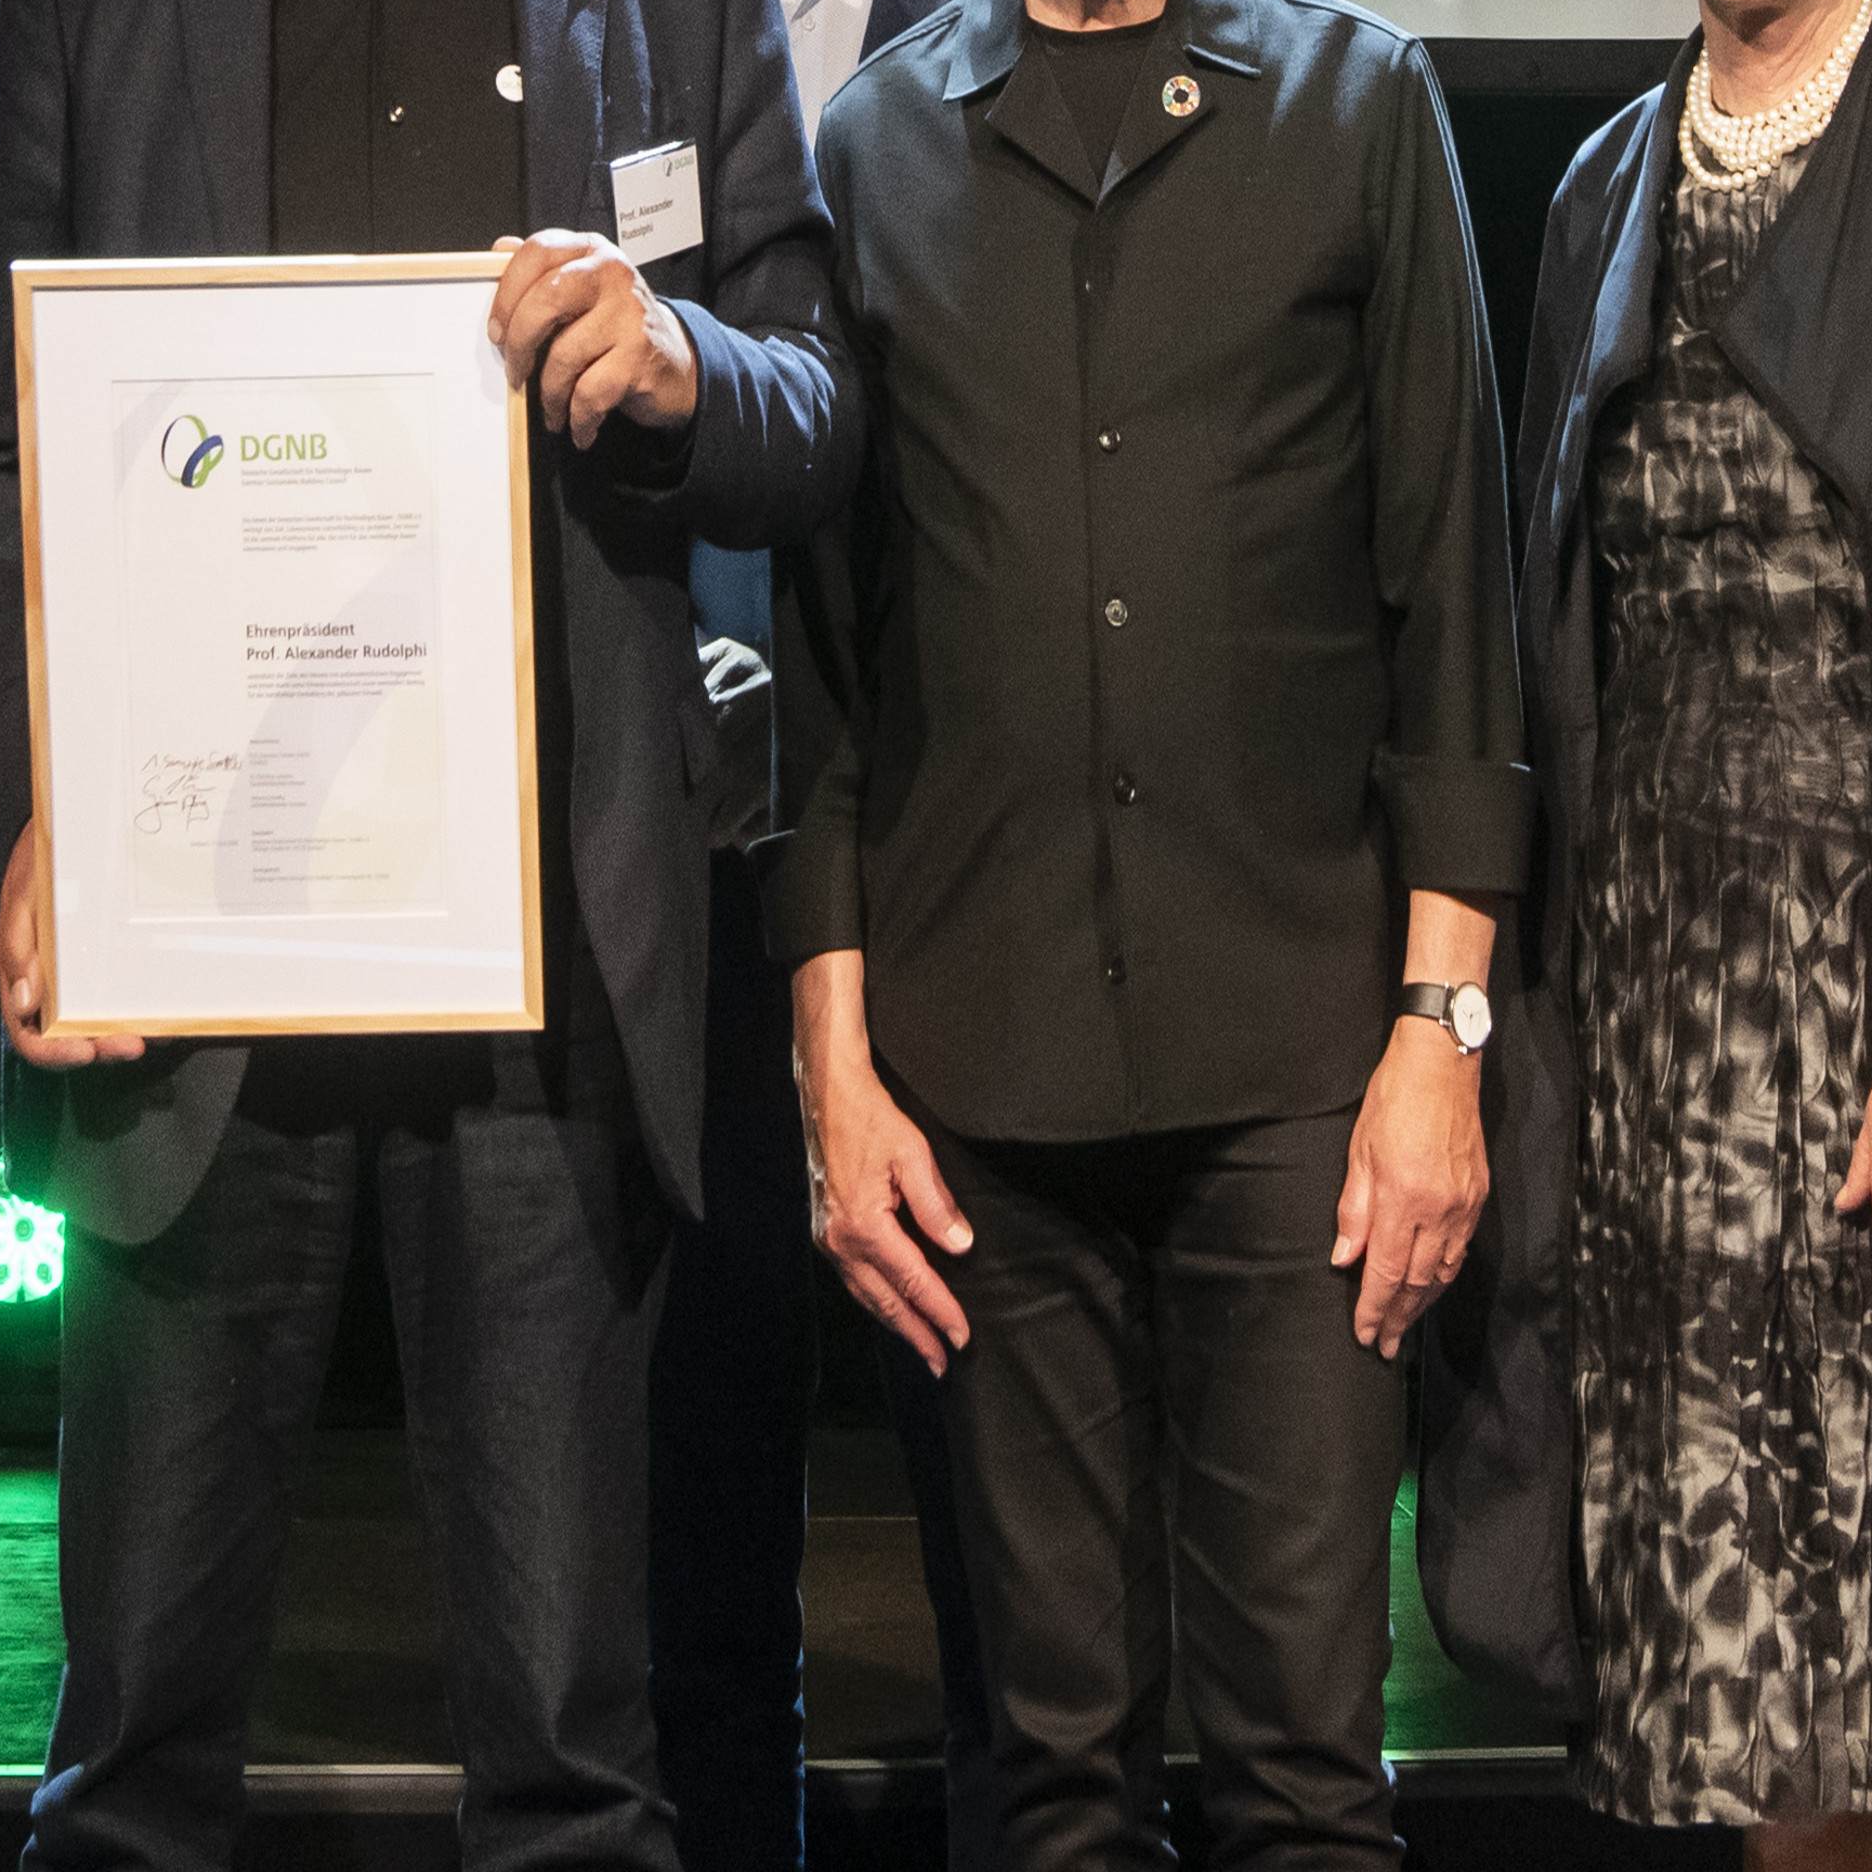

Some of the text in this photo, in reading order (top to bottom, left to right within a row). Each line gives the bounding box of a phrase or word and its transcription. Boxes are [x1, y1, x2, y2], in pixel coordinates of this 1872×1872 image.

[240, 433, 328, 462] DGNB
[246, 622, 355, 640] Ehrenpräsident
[246, 643, 427, 661] Prof. Alexander Rudolphi
